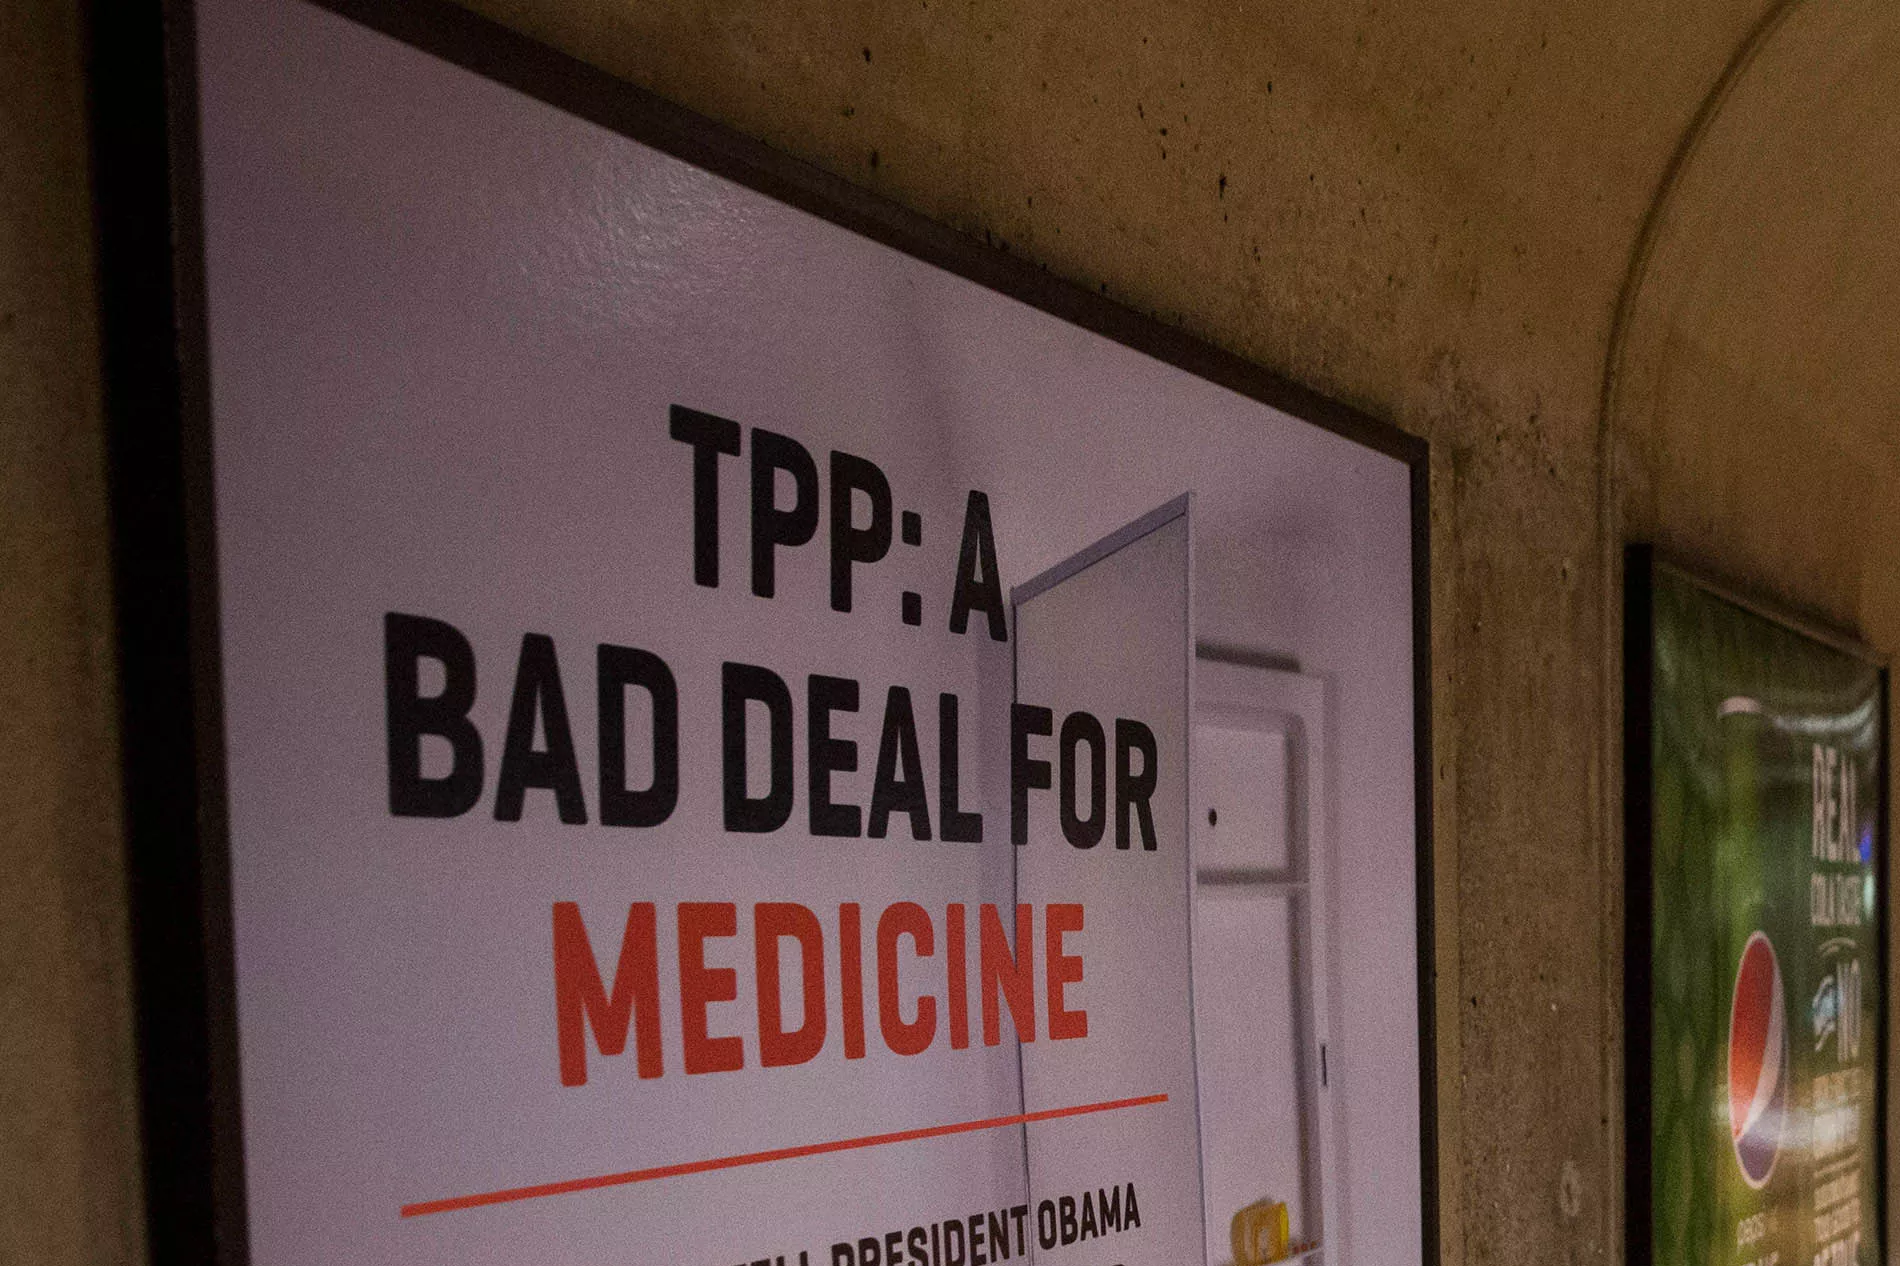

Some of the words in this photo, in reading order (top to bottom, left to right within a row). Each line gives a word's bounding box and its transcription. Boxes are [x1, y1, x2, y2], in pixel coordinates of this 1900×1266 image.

[668, 403, 922, 626] TPP:
[949, 489, 1008, 643] A
[383, 610, 679, 828] BAD
[720, 660, 983, 842] DEAL
[1010, 702, 1158, 851] FOR
[552, 900, 1089, 1087] MEDICINE
[1037, 1181, 1140, 1250] OBAMA
